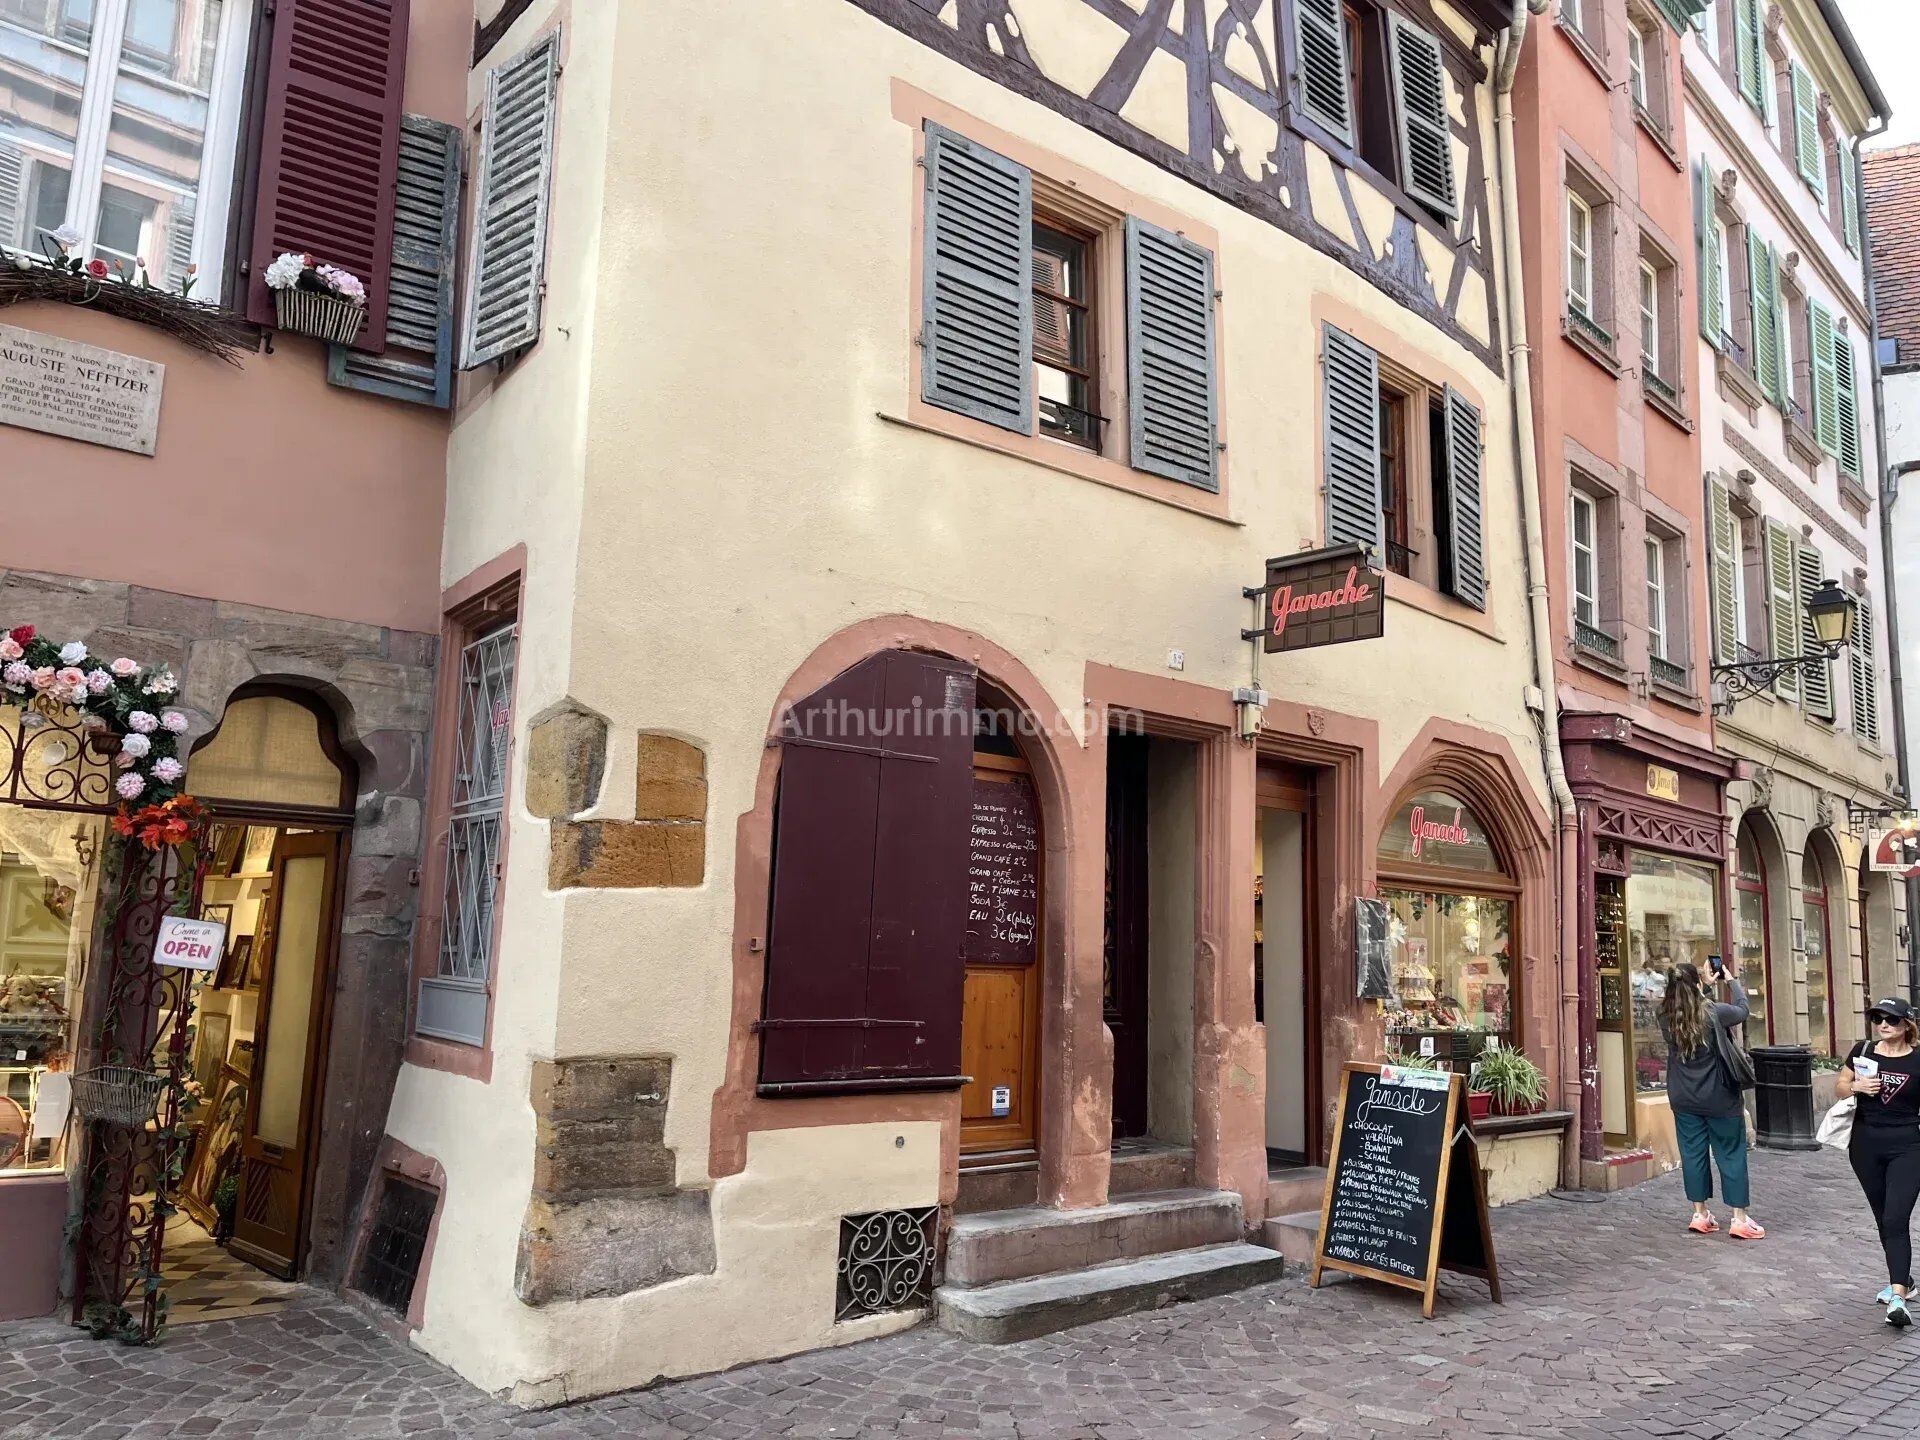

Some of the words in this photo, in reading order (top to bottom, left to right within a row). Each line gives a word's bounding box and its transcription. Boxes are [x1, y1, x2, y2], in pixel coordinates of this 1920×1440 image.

[14, 340, 34, 350] DANS
[40, 348, 66, 358] CETTE
[72, 356, 100, 366] MAISON
[108, 364, 120, 372] EST
[0, 348, 66, 374] AUGUSTE
[76, 366, 148, 394] NEFFTZER
[6, 376, 34, 388] GRAND
[40, 384, 92, 402] JOURNALISTE
[44, 374, 66, 384] 1820
[80, 382, 100, 394] 1874
[26, 398, 62, 412] JOURNAL
[970, 838, 1000, 848] EXPRESSO
[970, 852, 992, 862] GRAND
[994, 854, 1012, 864] CAFÉ
[968, 866, 990, 876] GRAND
[992, 868, 1012, 878] CAFÉ
[970, 894, 990, 906] SODA
[970, 910, 988, 920] EAU
[172, 922, 198, 935] Come
[164, 941, 211, 958] OPEN
[1877, 1073, 1901, 1085] UESS
[1354, 1122, 1394, 1134] CHOCOLAT
[1364, 1134, 1404, 1146] VALRHONA
[1364, 1152, 1392, 1164] SCHAAL
[1346, 1168, 1376, 1182] MACARONS
[1390, 1258, 1416, 1276] ENTIERS
